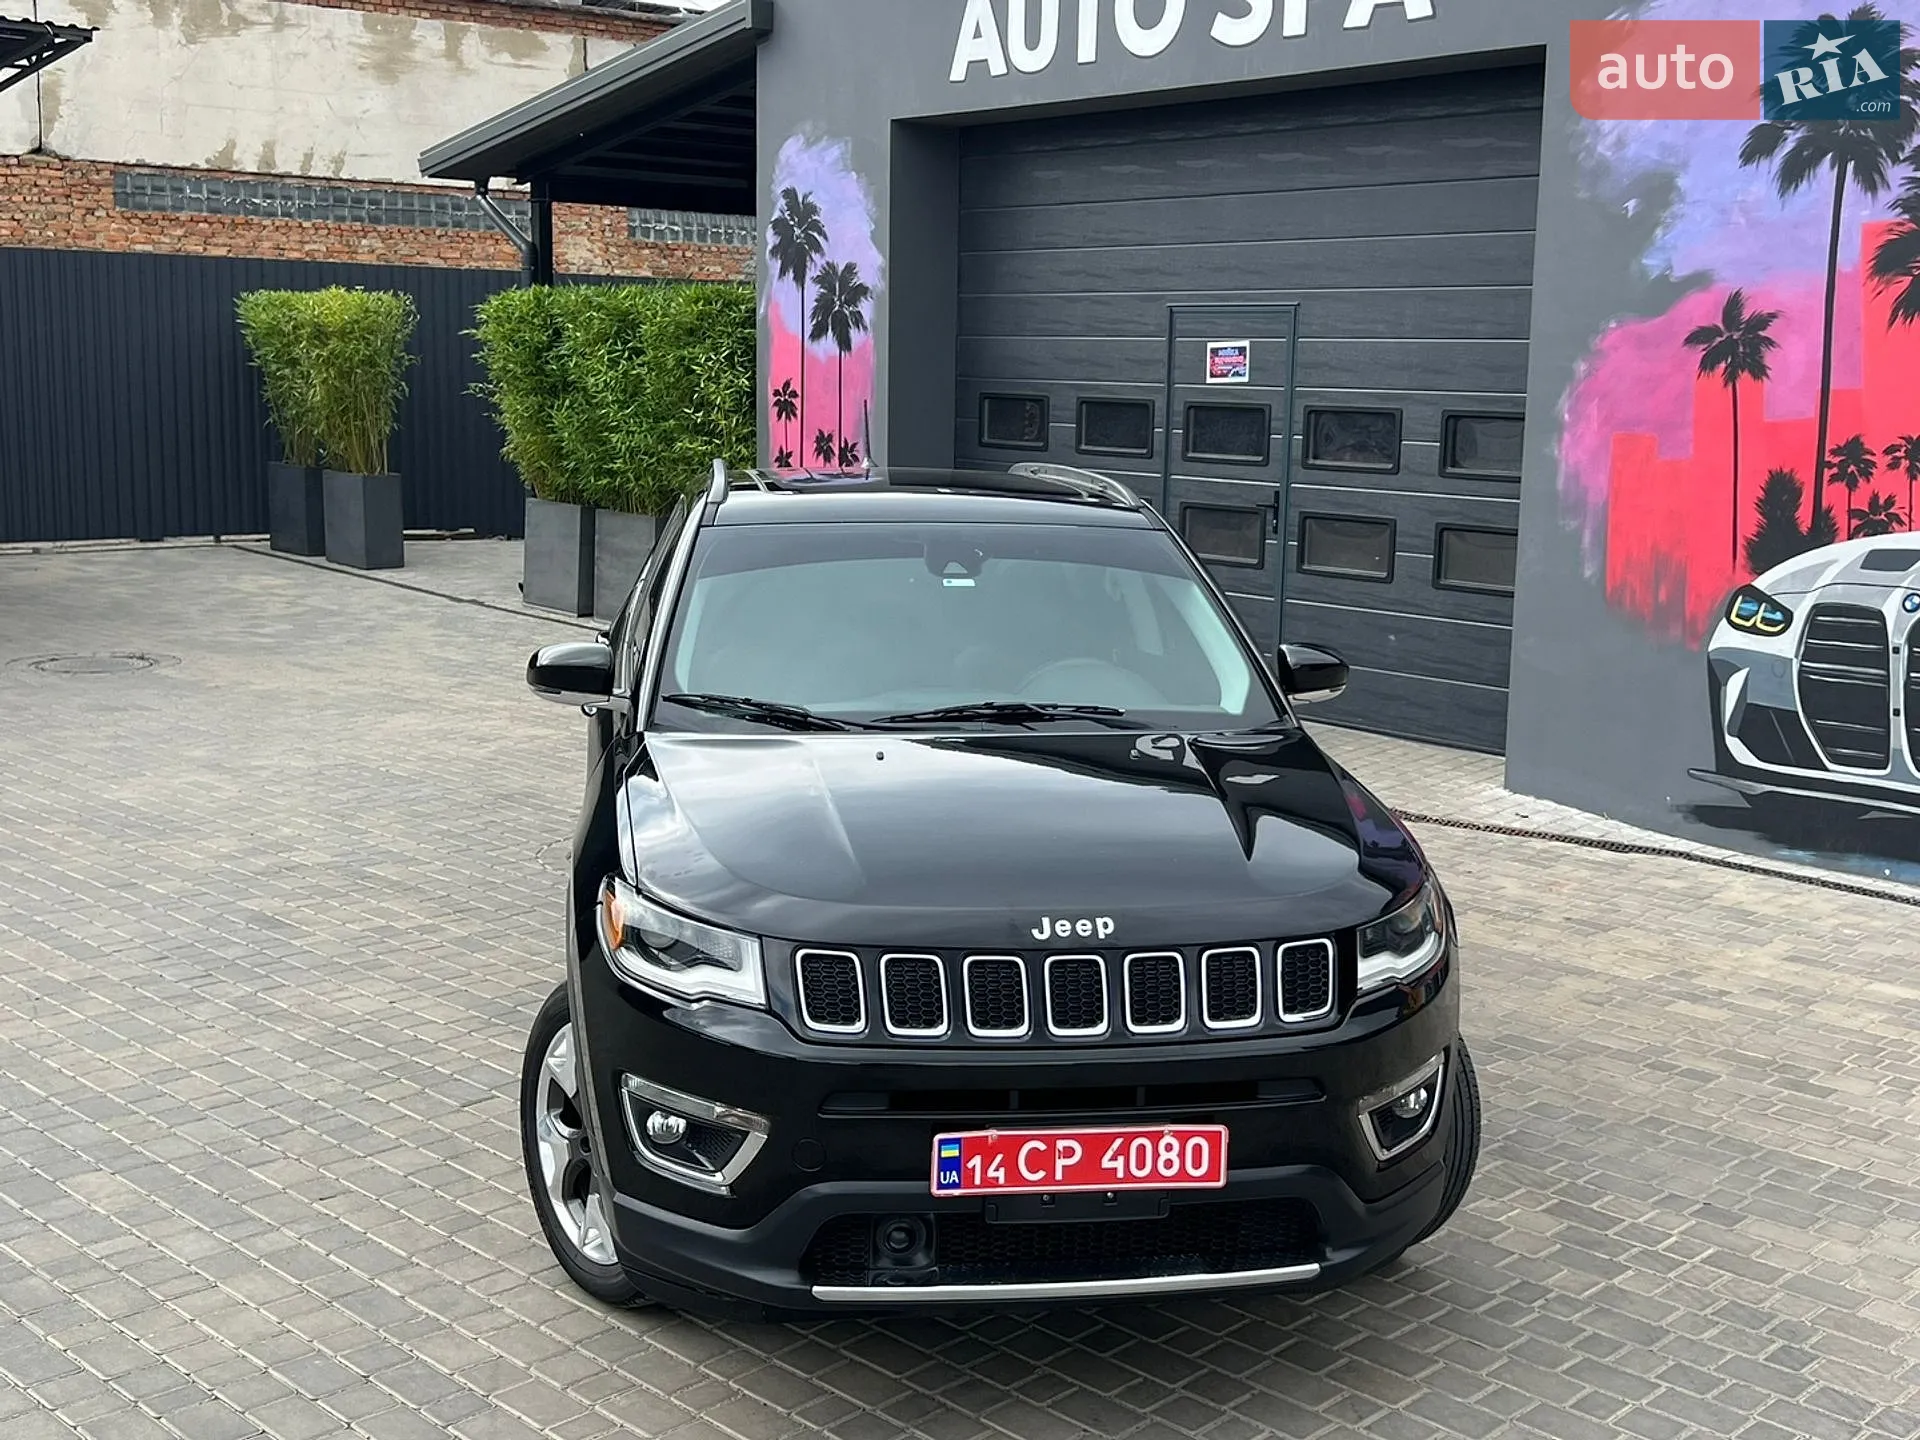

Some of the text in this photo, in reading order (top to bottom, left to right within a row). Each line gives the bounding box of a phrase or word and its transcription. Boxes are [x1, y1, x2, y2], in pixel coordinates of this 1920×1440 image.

[1031, 916, 1115, 940] Jeep
[966, 1153, 1005, 1186] 14
[1100, 1135, 1210, 1179] 4080
[940, 1170, 960, 1184] UA
